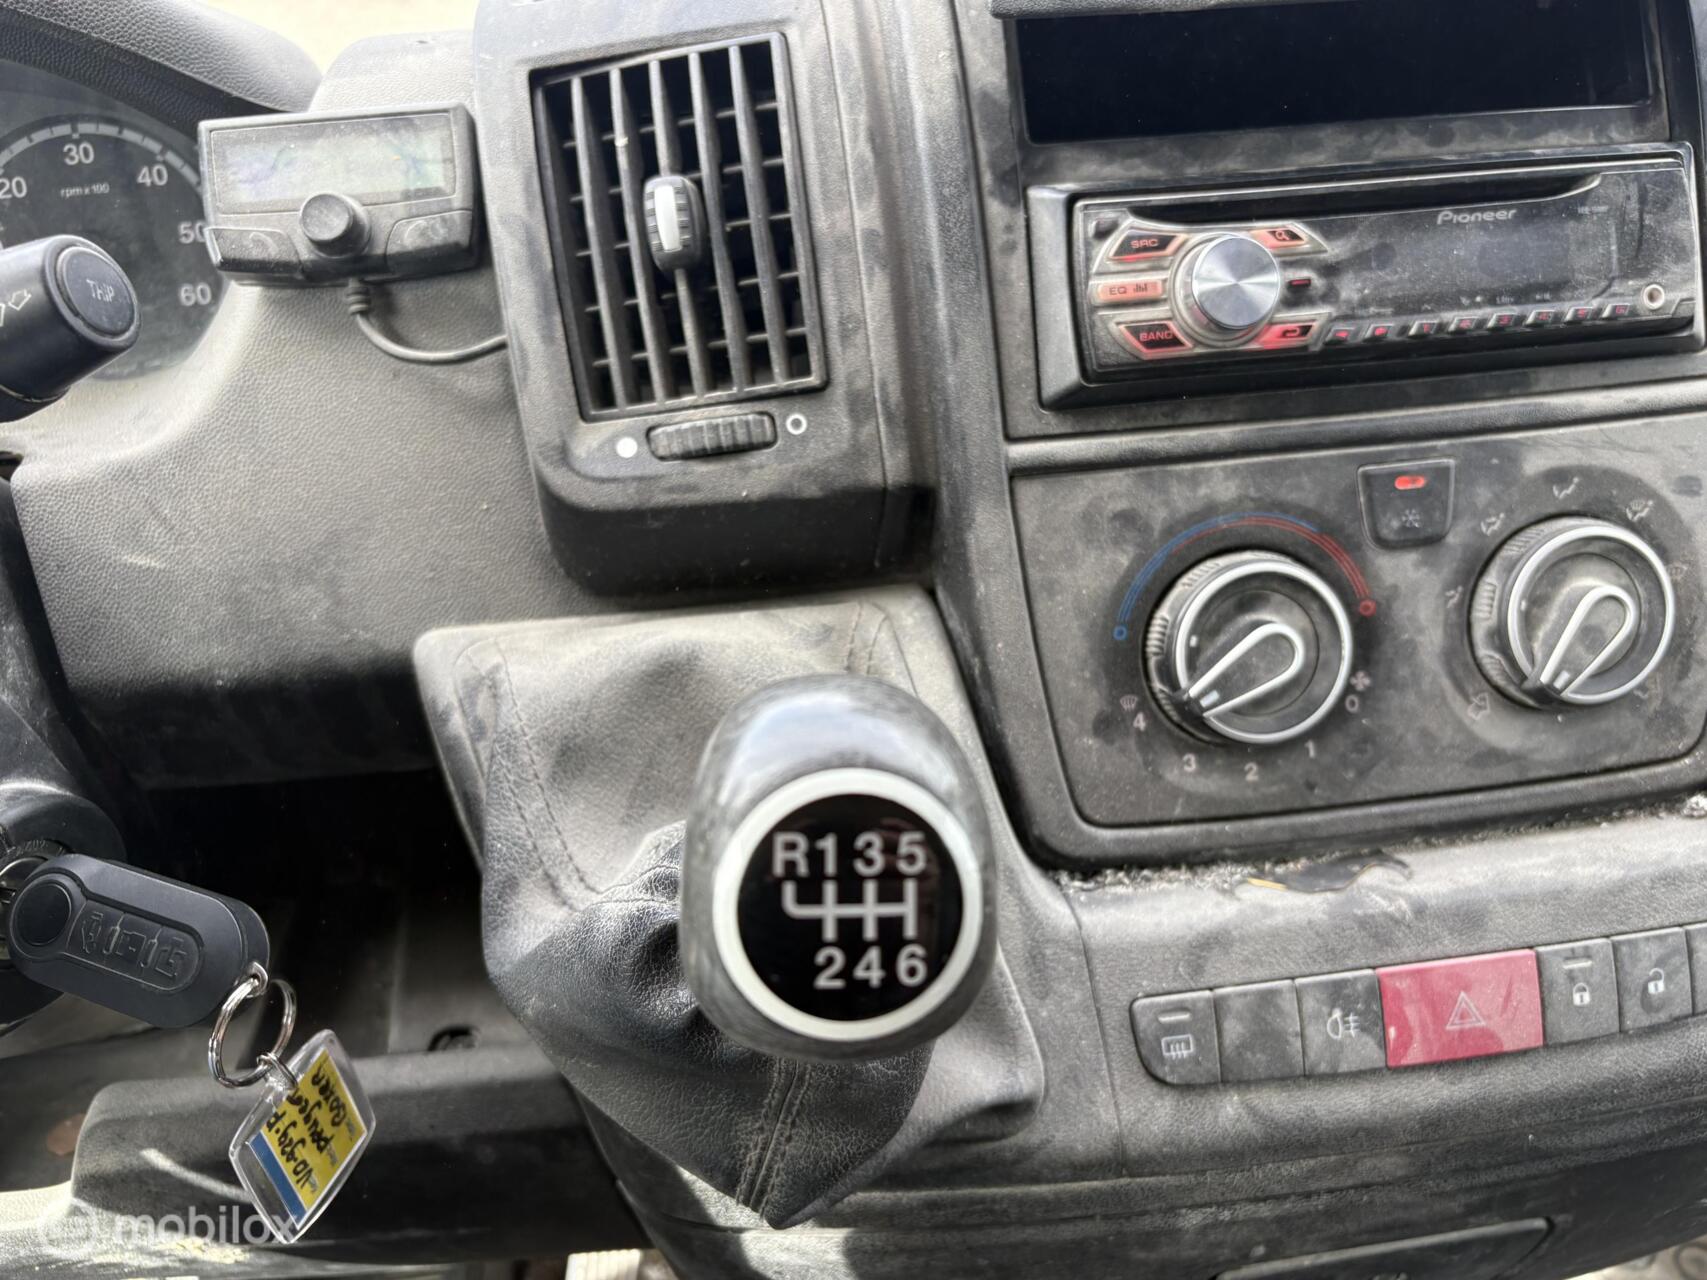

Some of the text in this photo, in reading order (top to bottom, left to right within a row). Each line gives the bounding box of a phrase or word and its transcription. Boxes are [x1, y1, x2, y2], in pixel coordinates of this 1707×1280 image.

[63, 142, 95, 165] 30
[136, 164, 168, 187] 40
[0, 176, 27, 199] 20
[61, 187, 83, 198] rpm
[92, 182, 110, 194] 100
[1437, 209, 1517, 225] Pioneer
[178, 221, 206, 244] 50
[1130, 238, 1159, 248] SRC
[180, 282, 212, 306] 60
[1109, 286, 1127, 295] EQ
[1139, 331, 1174, 341] BAND
[1133, 712, 1146, 731] 4
[1305, 740, 1316, 758] 1
[1182, 753, 1197, 771] 3
[1244, 763, 1259, 781] 2
[772, 831, 927, 878] R 1 3 5
[812, 943, 927, 990] 2 4 6
